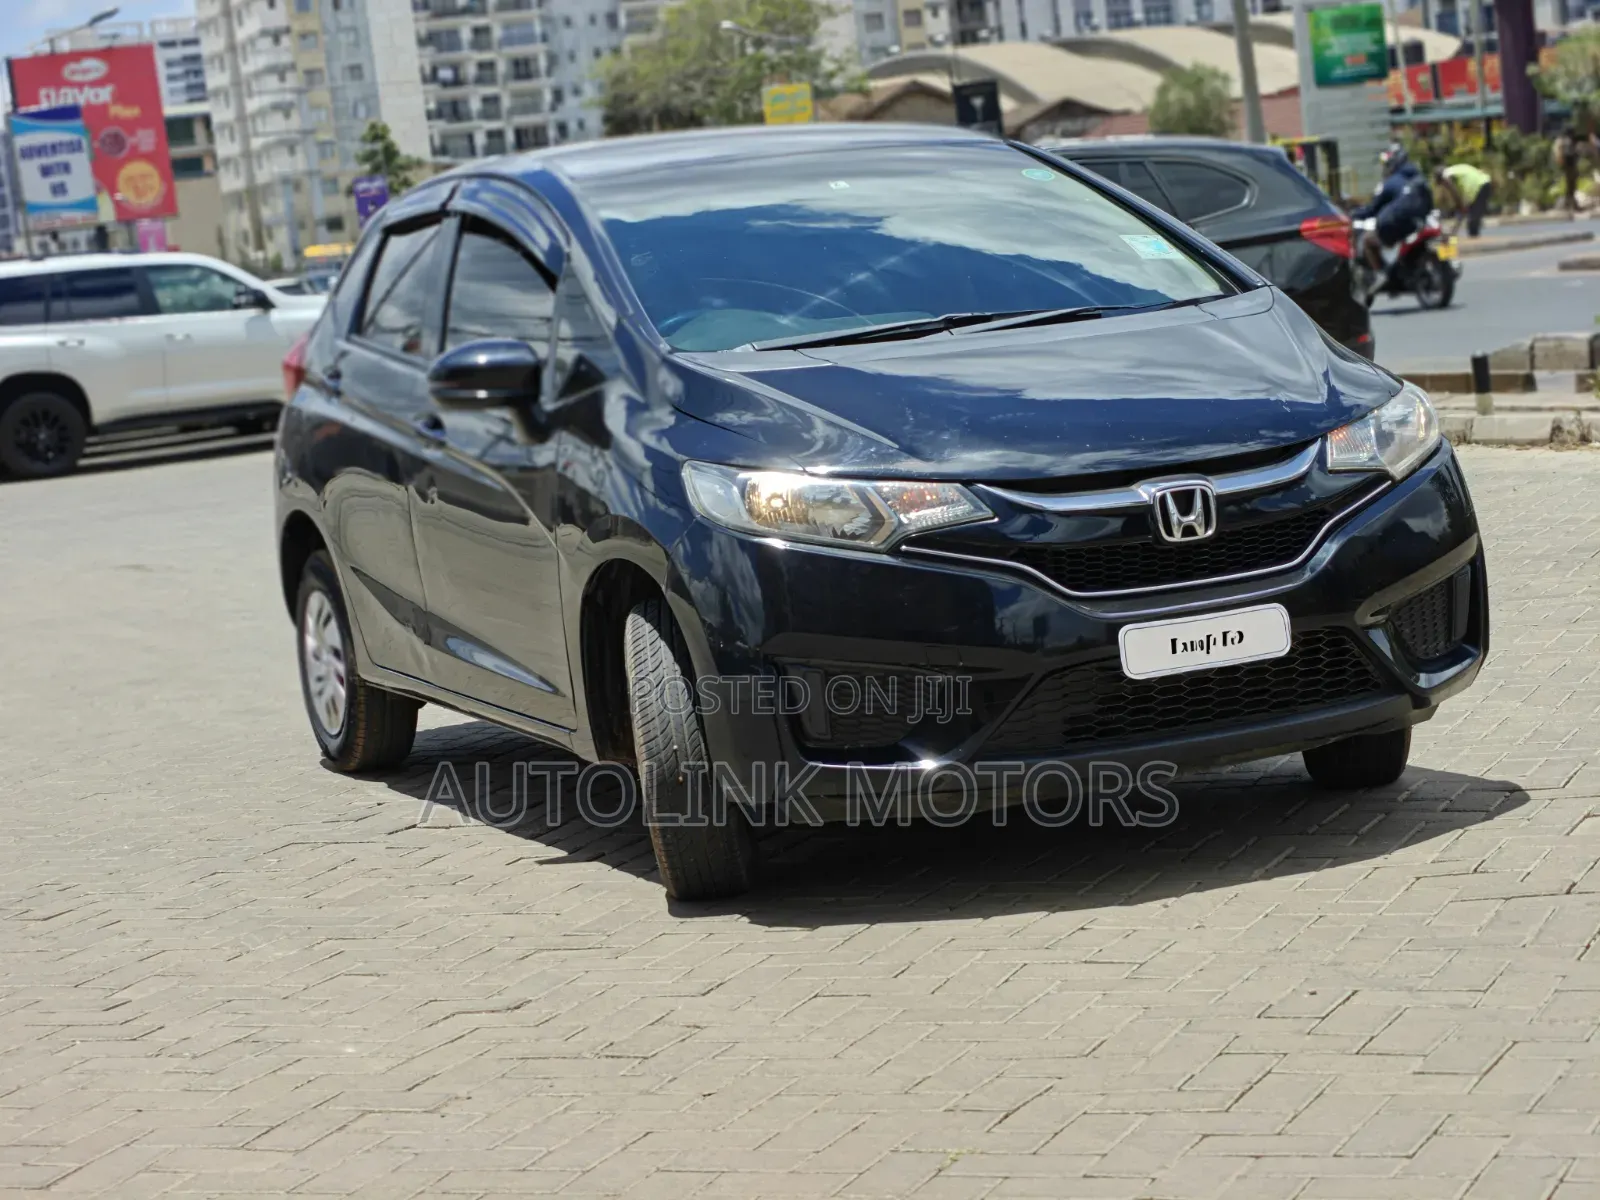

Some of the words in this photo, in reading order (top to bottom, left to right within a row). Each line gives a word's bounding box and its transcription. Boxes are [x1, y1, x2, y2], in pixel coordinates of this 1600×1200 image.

[20, 137, 84, 160] ADVERTISE
[39, 162, 72, 178] WITH
[50, 181, 69, 198] US
